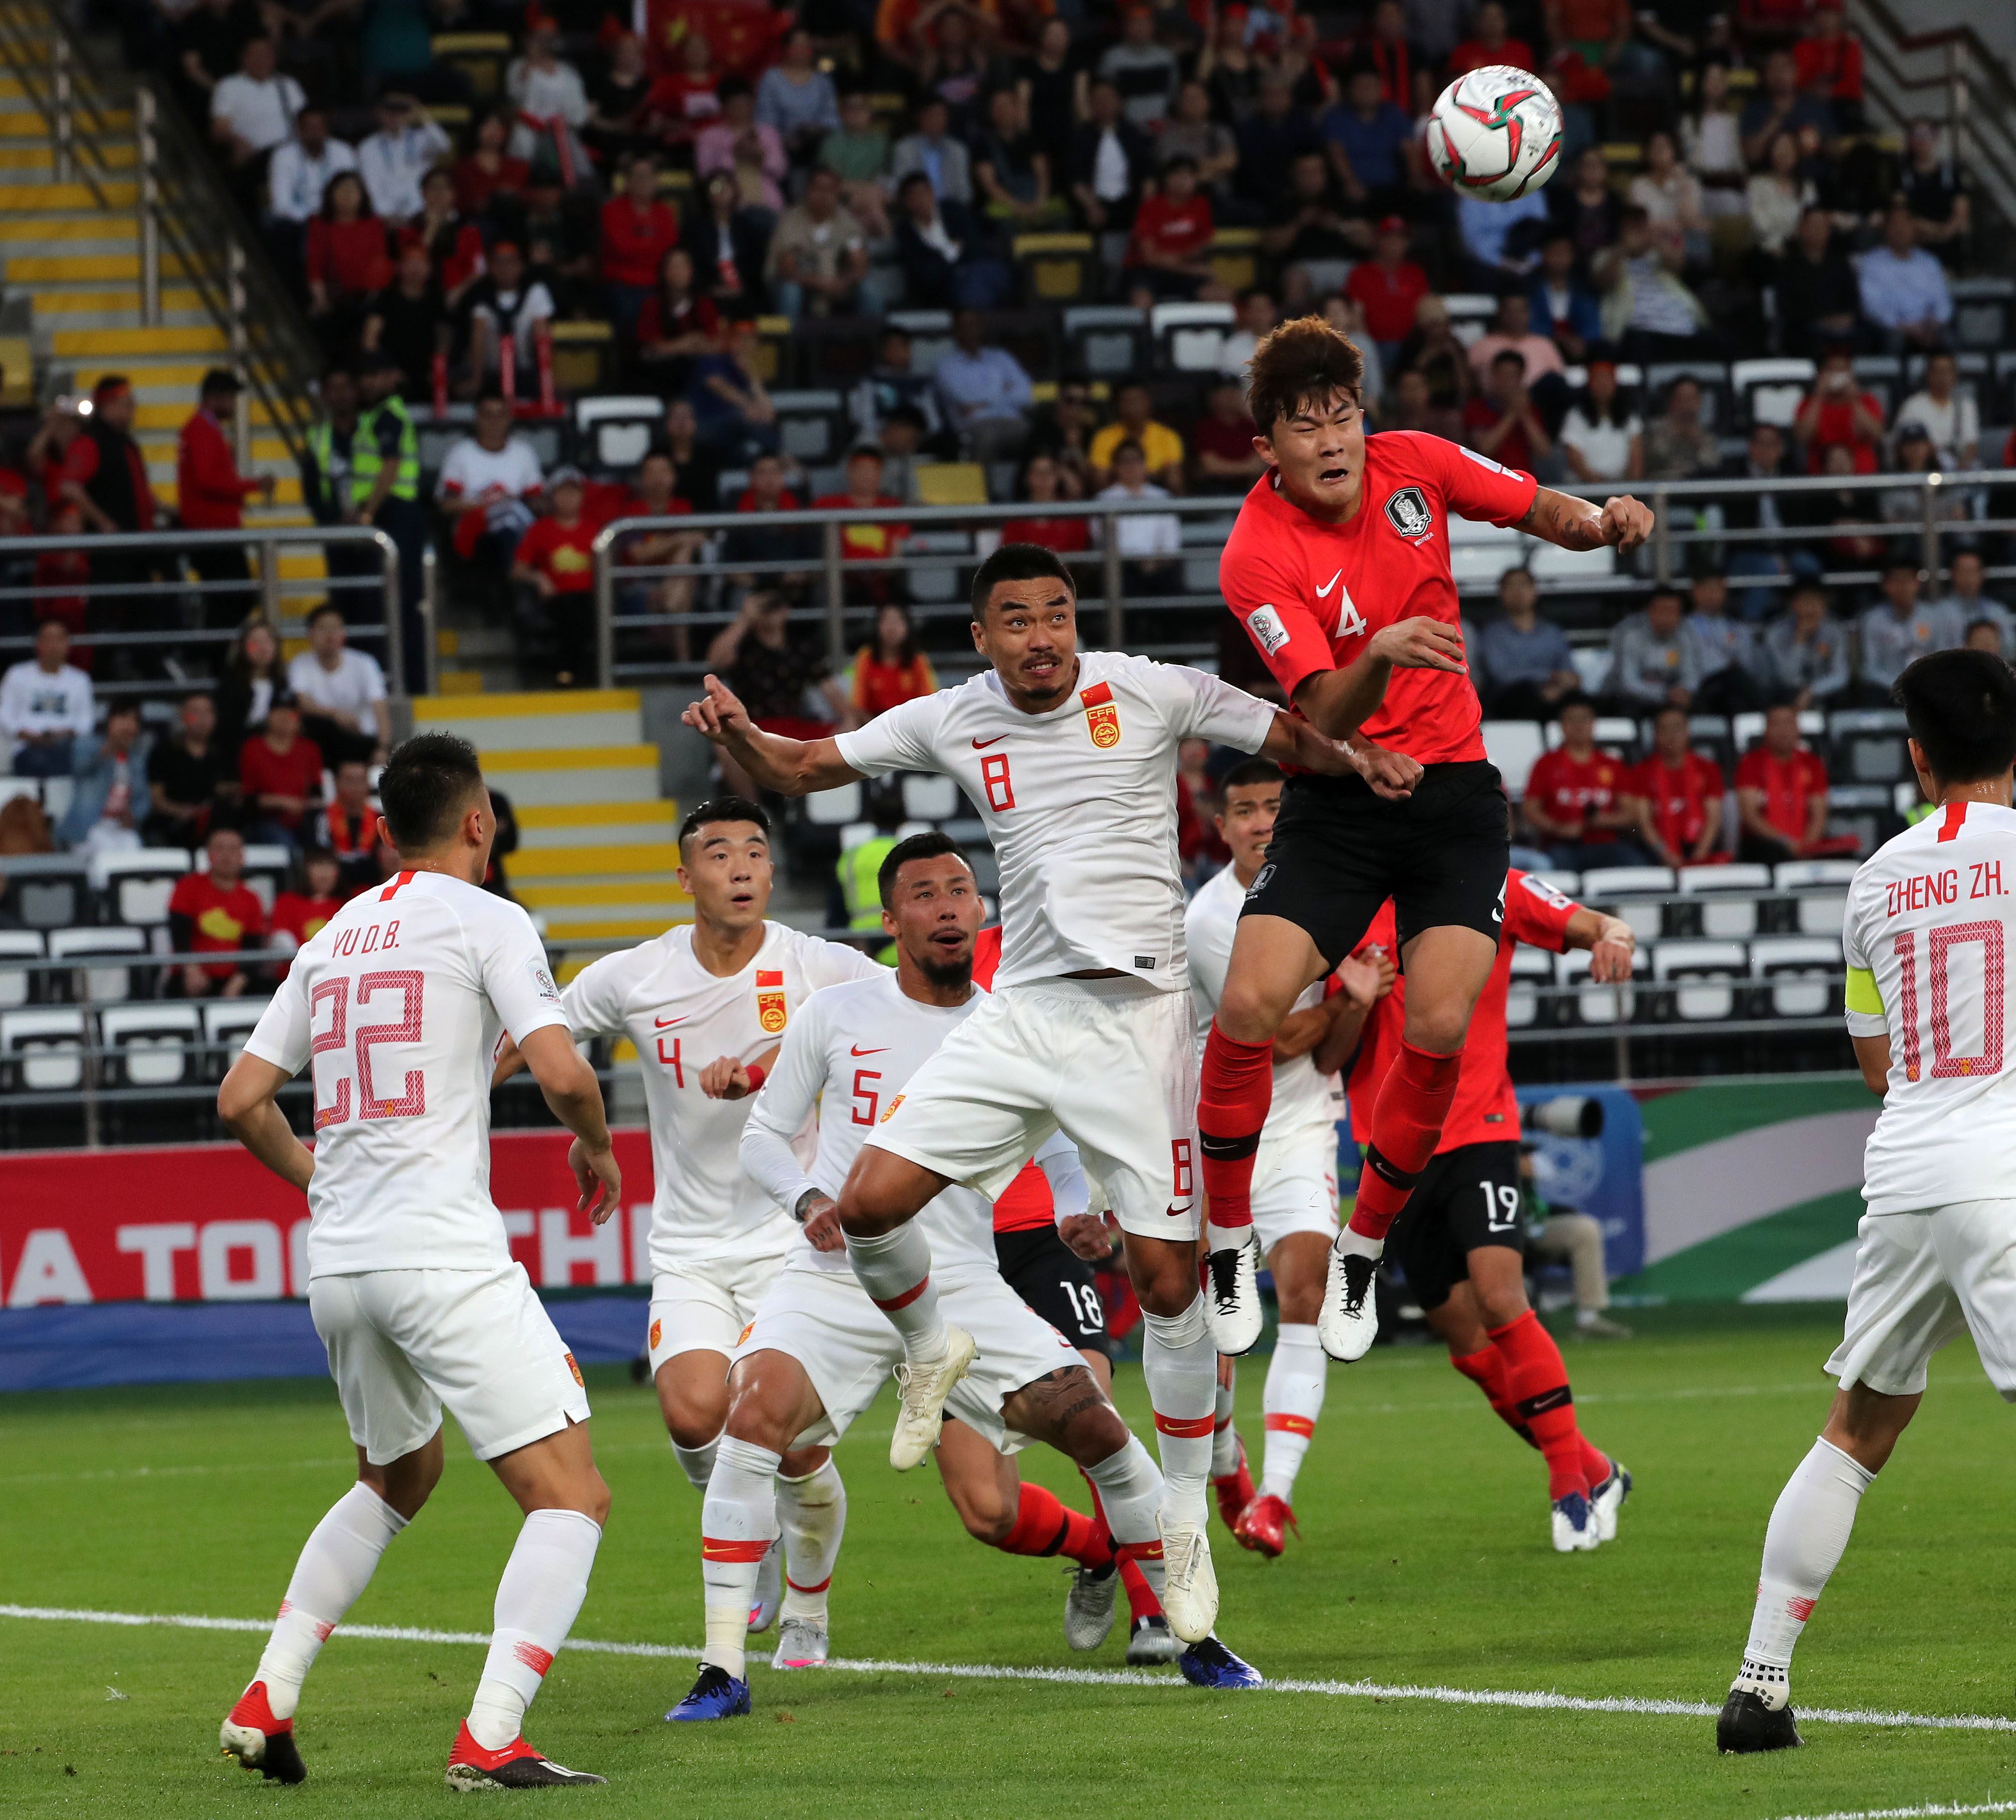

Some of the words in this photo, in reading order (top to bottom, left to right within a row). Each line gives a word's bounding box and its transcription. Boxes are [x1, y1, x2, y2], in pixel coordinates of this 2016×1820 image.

[1414, 531, 1434, 547] KOREA
[1335, 585, 1367, 638] 4
[1088, 707, 1115, 720] CFA
[981, 753, 1015, 812] 8
[1886, 869, 1958, 917] ZHENG
[1969, 860, 2010, 900] ZH.
[332, 927, 354, 958] YU
[361, 920, 400, 954] D.B.
[759, 994, 784, 1004] CFA
[1894, 919, 2005, 1082] 10
[311, 970, 425, 1132] 22
[657, 1038, 684, 1088] 4
[852, 1069, 882, 1126] 5
[1172, 1138, 1193, 1196] 8
[1480, 1180, 1519, 1222] 19
[1060, 1281, 1104, 1328] 18
